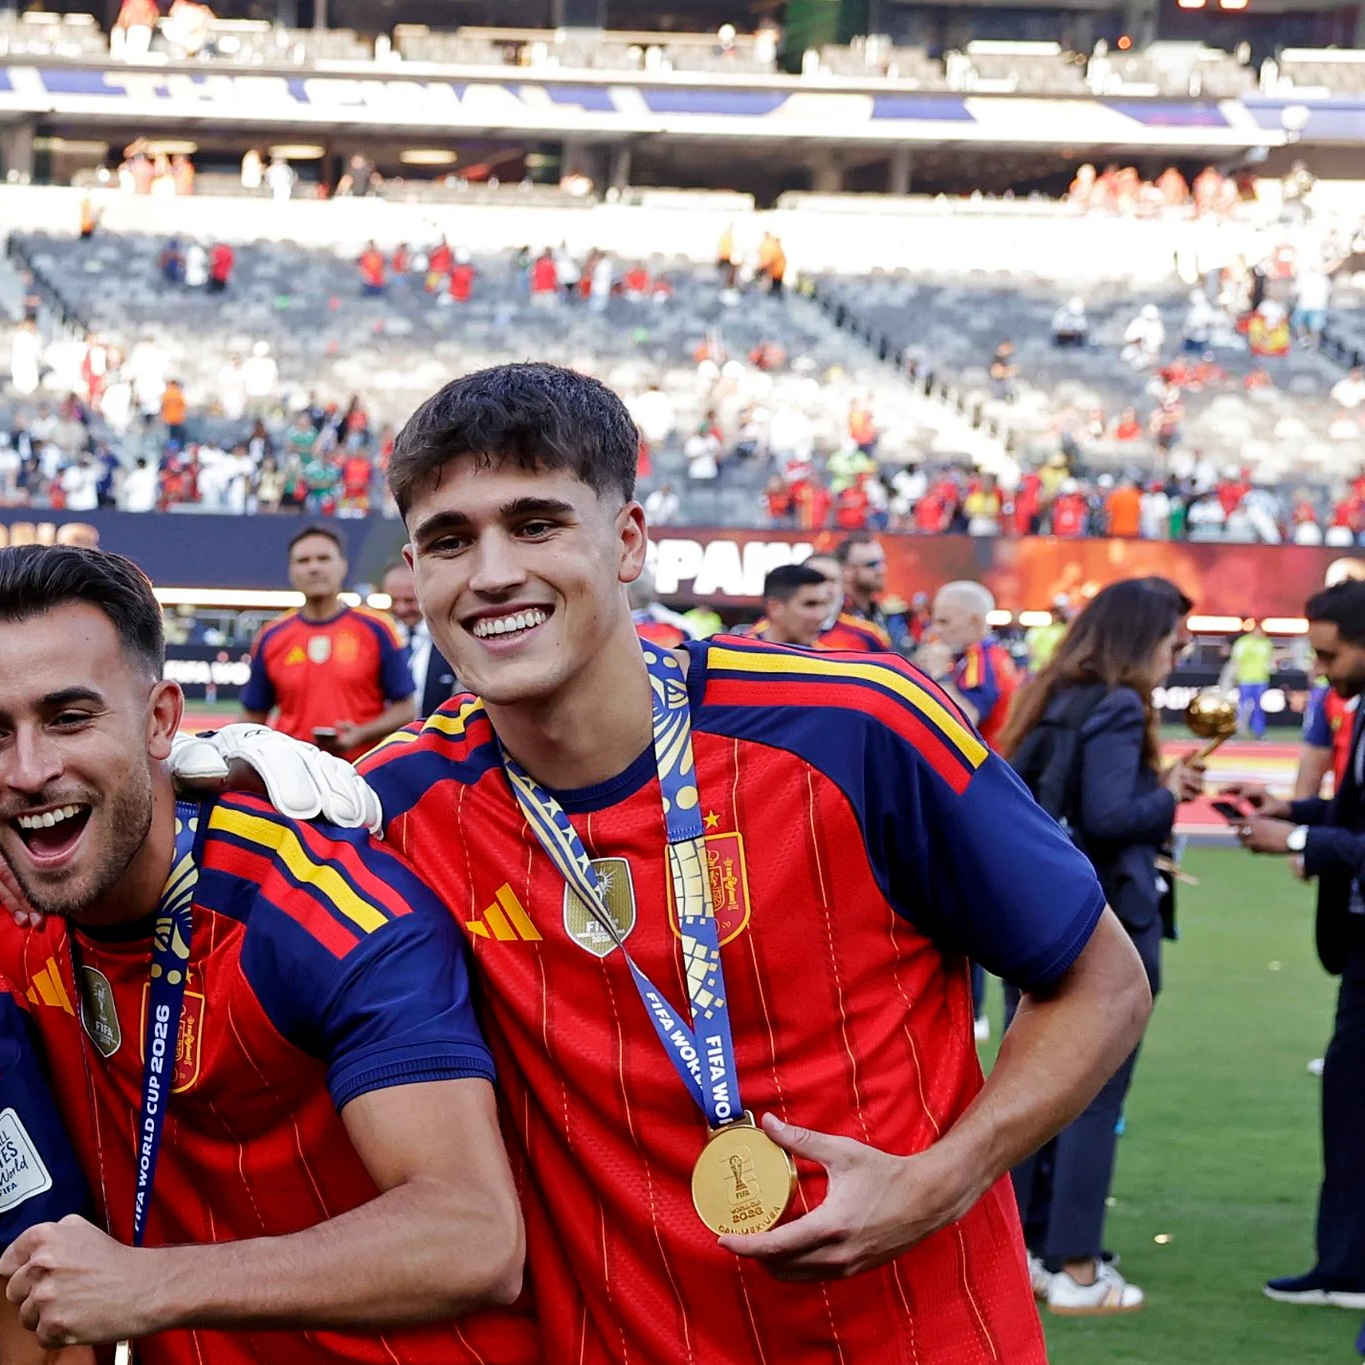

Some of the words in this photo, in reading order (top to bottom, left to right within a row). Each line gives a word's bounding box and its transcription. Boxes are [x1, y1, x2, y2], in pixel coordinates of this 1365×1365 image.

[95, 1021, 114, 1039] FIFA
[646, 991, 676, 1032] FIFA
[149, 1004, 171, 1074] 2026
[705, 1035, 727, 1083] FIFA
[146, 1075, 161, 1116] CUP
[138, 1117, 156, 1187] WORLD
[735, 1189, 752, 1200] FIFA
[732, 1207, 765, 1225] 2026
